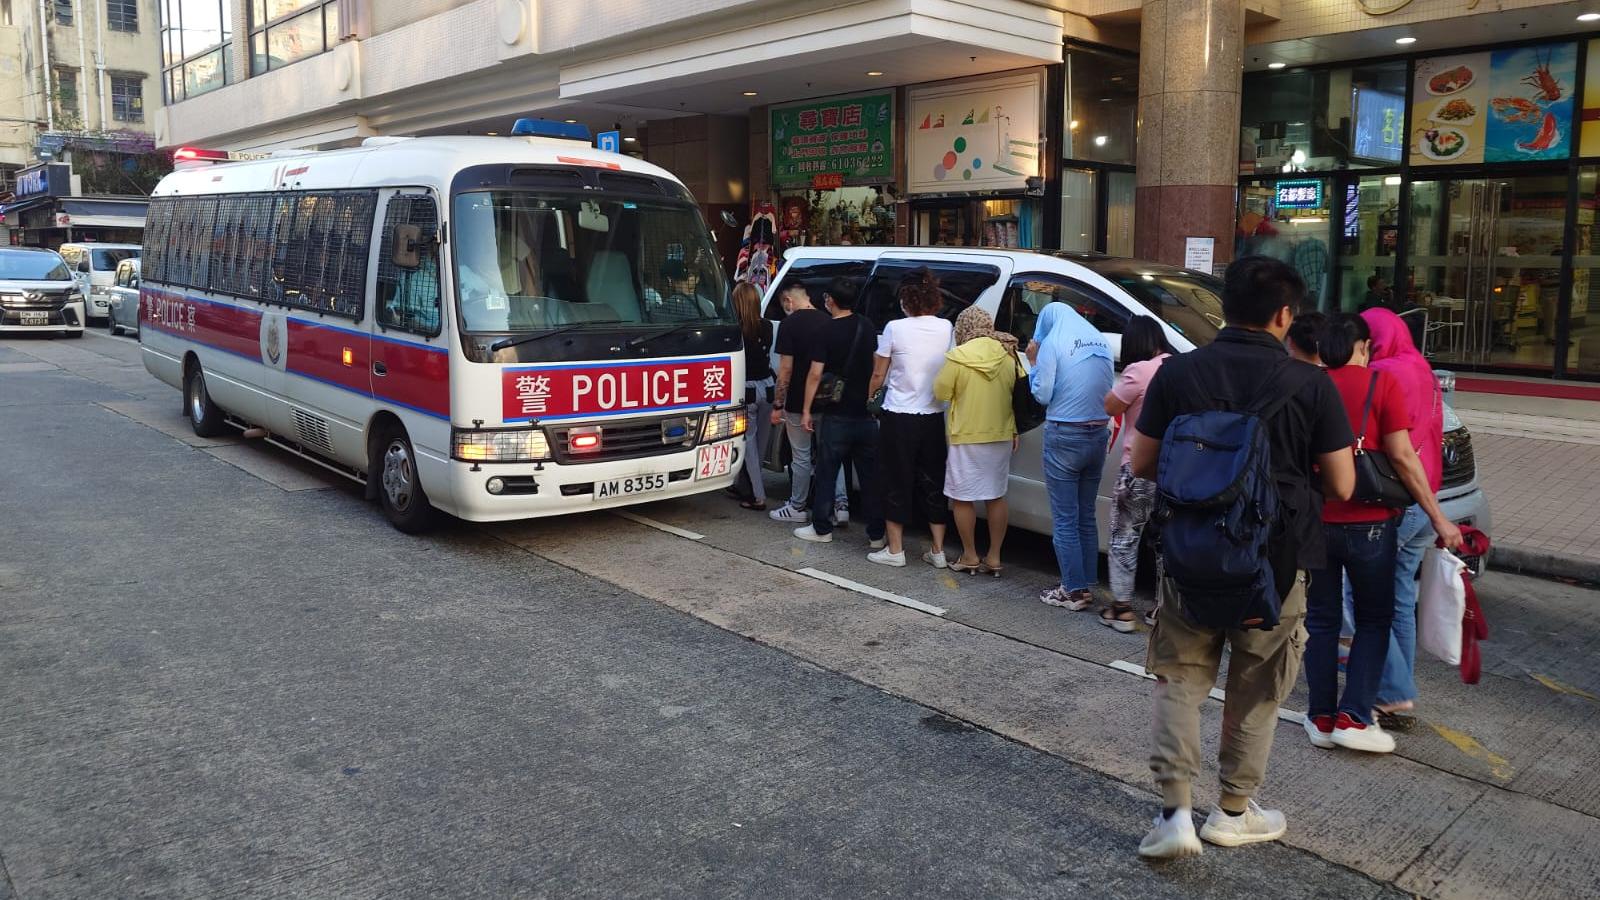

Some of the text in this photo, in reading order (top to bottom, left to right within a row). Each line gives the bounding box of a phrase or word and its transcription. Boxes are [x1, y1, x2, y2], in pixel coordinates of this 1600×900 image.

[799, 105, 862, 131] 尋寶店
[156, 298, 185, 331] POLICE
[515, 365, 725, 413] 警 POLICE 察
[701, 446, 729, 462] NTN
[701, 460, 726, 477] 4/3
[599, 474, 664, 497] AM 8355
